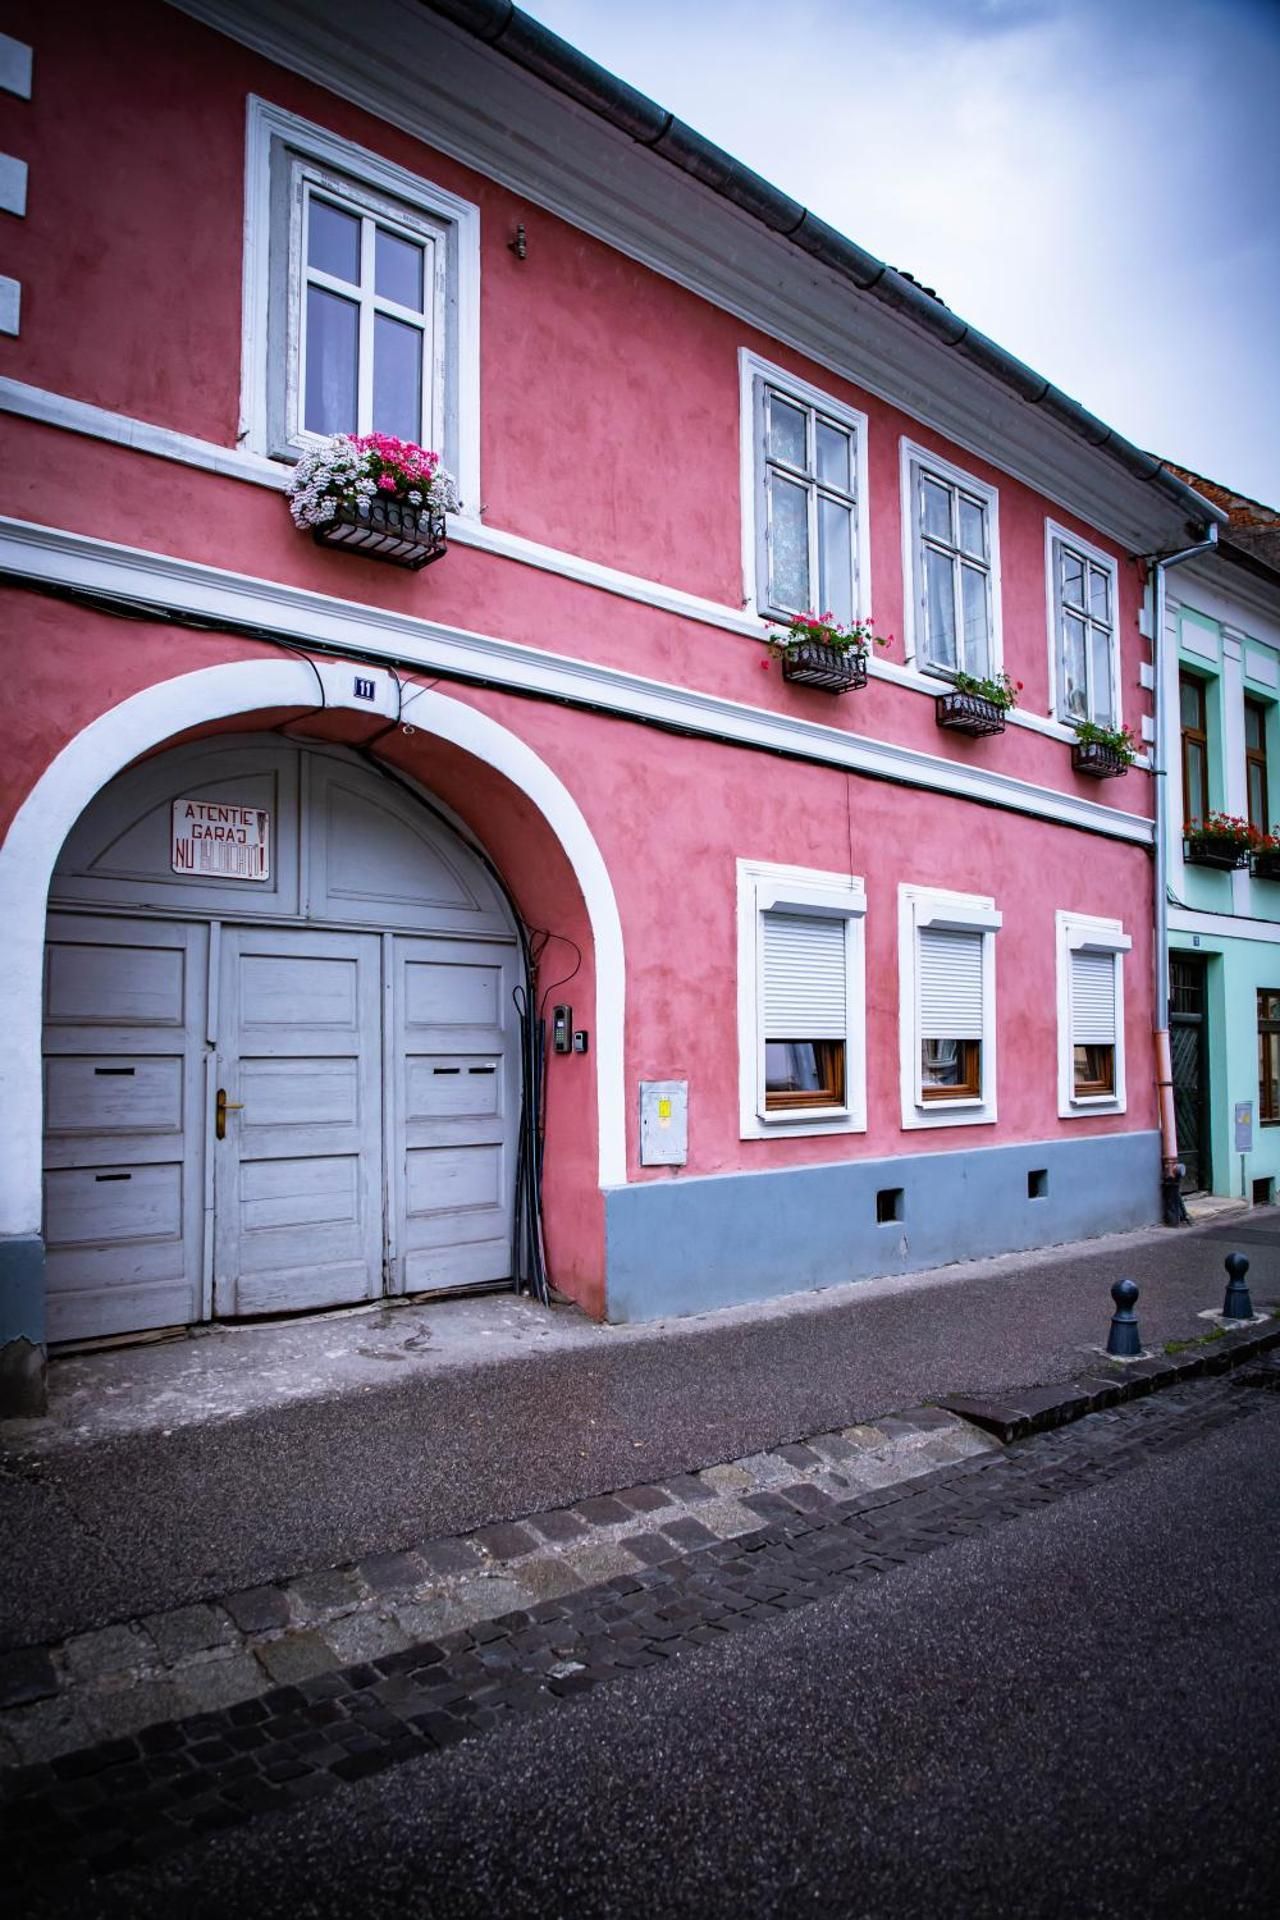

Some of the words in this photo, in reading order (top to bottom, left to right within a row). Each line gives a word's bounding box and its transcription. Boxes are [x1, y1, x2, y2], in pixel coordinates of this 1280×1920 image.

[360, 681, 371, 696] 11
[192, 824, 247, 844] GARAJ
[176, 838, 194, 869] NU
